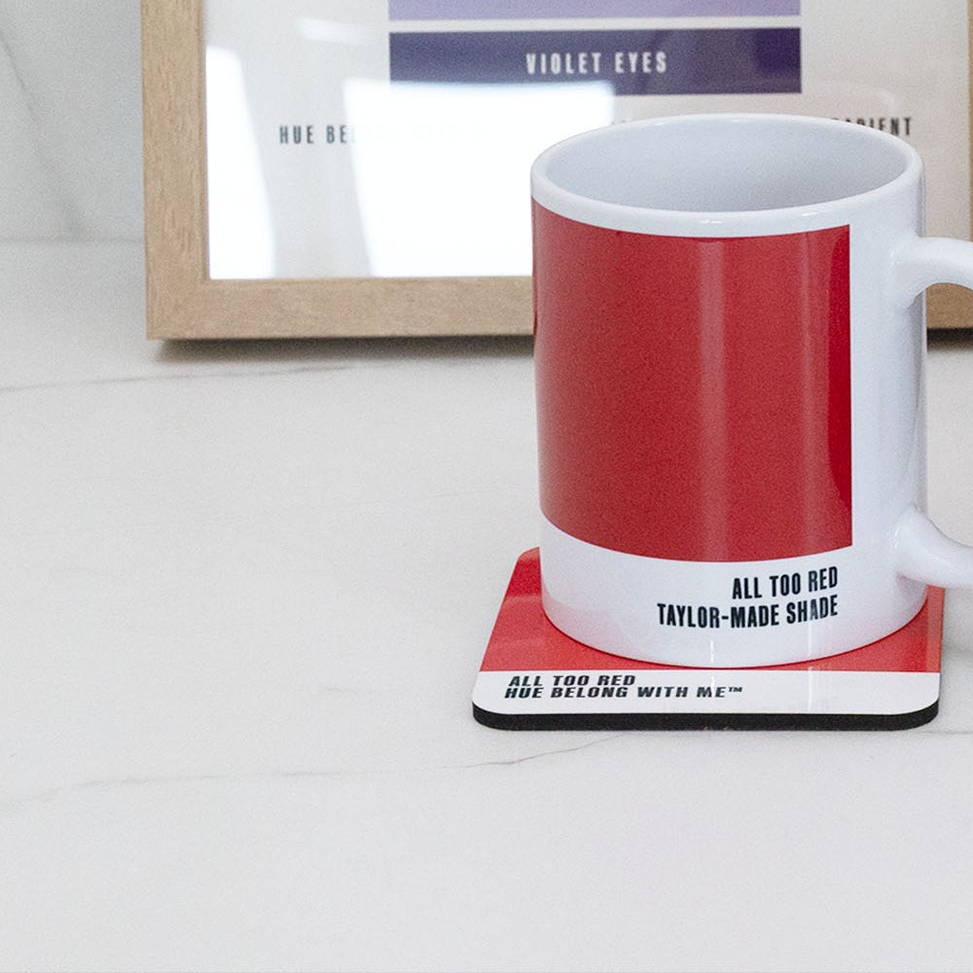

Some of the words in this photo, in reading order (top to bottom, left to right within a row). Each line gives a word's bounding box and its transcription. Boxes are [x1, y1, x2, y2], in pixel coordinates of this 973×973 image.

[525, 52, 601, 75] VIOLET
[614, 50, 667, 74] EYES
[279, 124, 314, 145] HUE
[731, 576, 763, 600] ALL
[769, 571, 802, 598] TOO
[807, 565, 838, 593] RED
[656, 602, 780, 629] TAYLOR-MADE
[786, 595, 838, 624] SHADE
[508, 676, 542, 687] ALL
[553, 675, 590, 686] TOO
[597, 675, 636, 686] RED
[504, 687, 544, 700] HUE
[550, 686, 628, 699] BELONG
[637, 687, 689, 698] WITH
